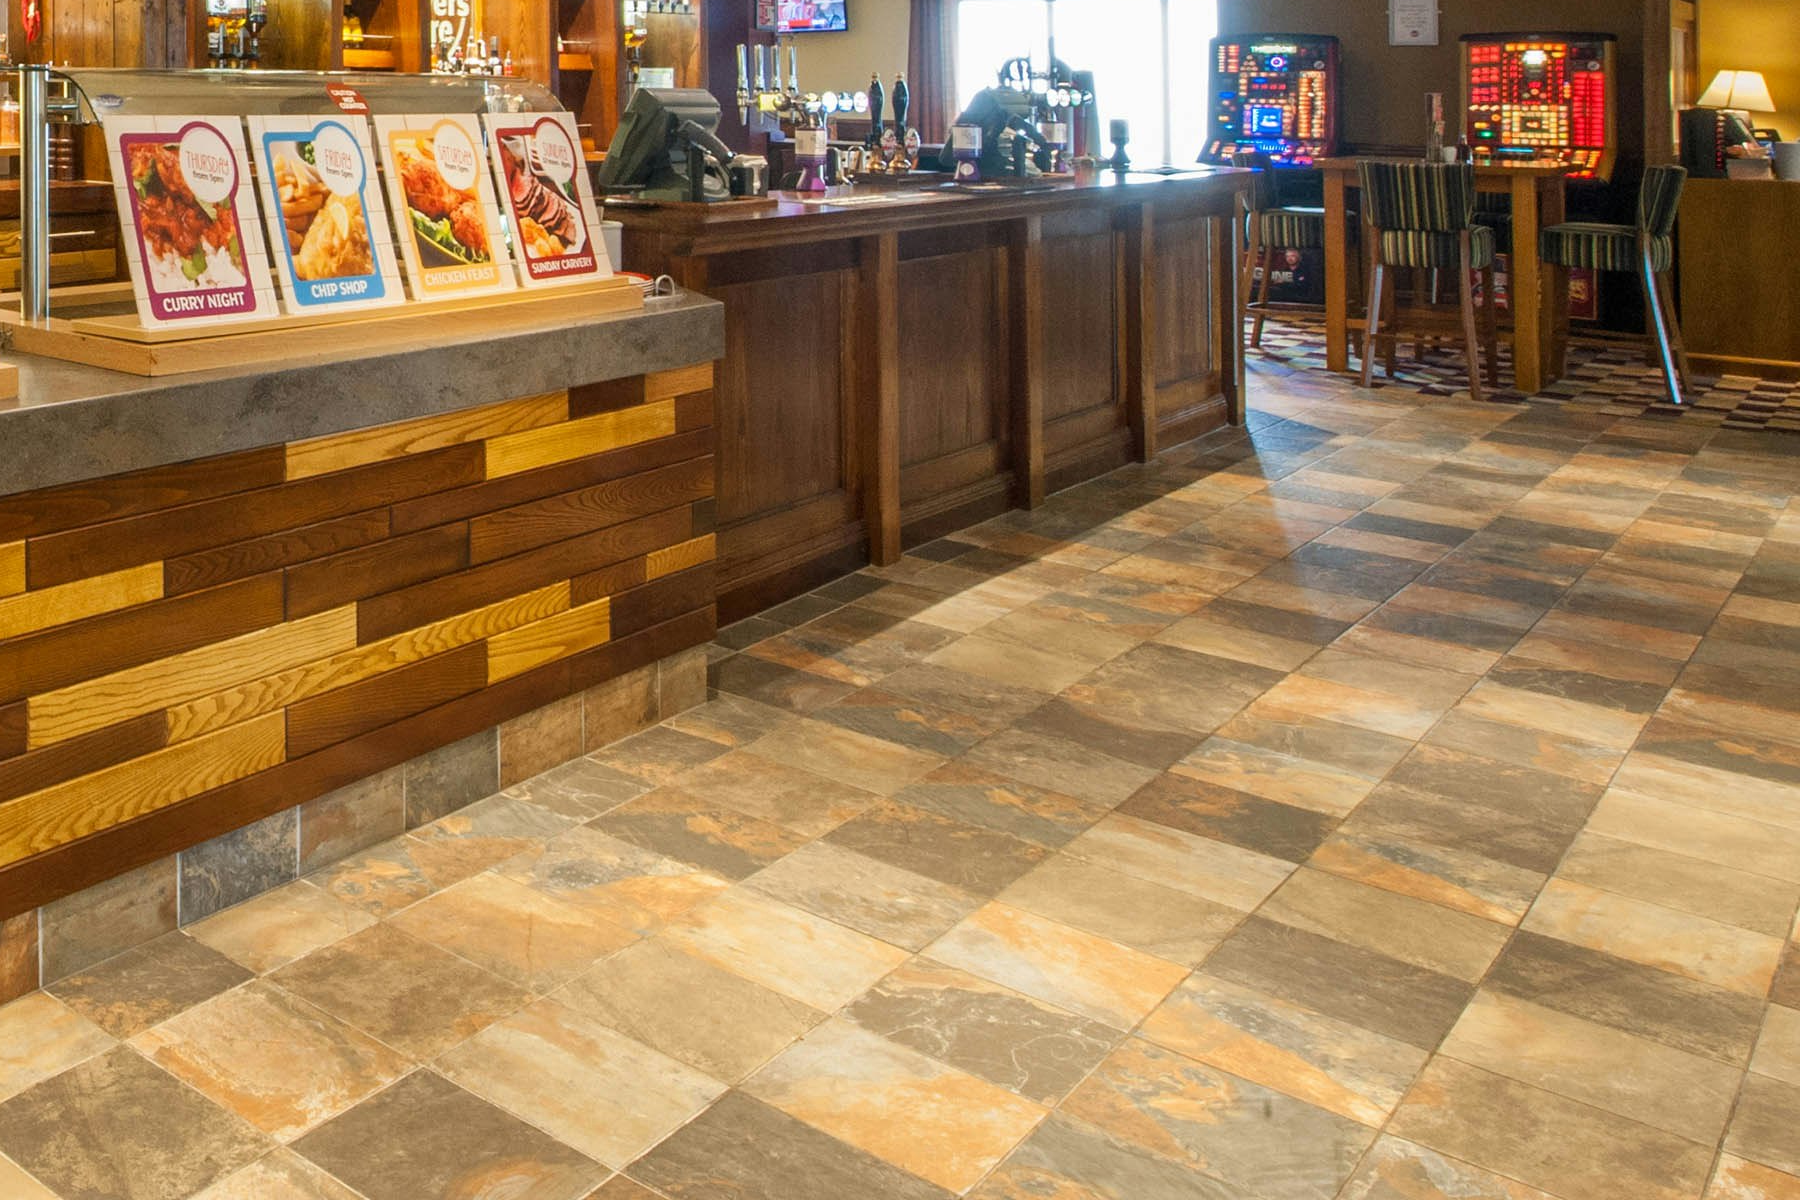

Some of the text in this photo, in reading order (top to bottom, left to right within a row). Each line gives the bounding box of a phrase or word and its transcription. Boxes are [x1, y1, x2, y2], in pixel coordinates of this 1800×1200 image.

[185, 150, 230, 176] THURSDAY
[324, 148, 352, 169] FRIDAY
[531, 256, 593, 274] SUNDAY CARVERY
[424, 266, 495, 286] CHICKEN FEAST
[311, 280, 368, 298] CHIP SHOP
[163, 291, 244, 312] CURRY NIGHT
